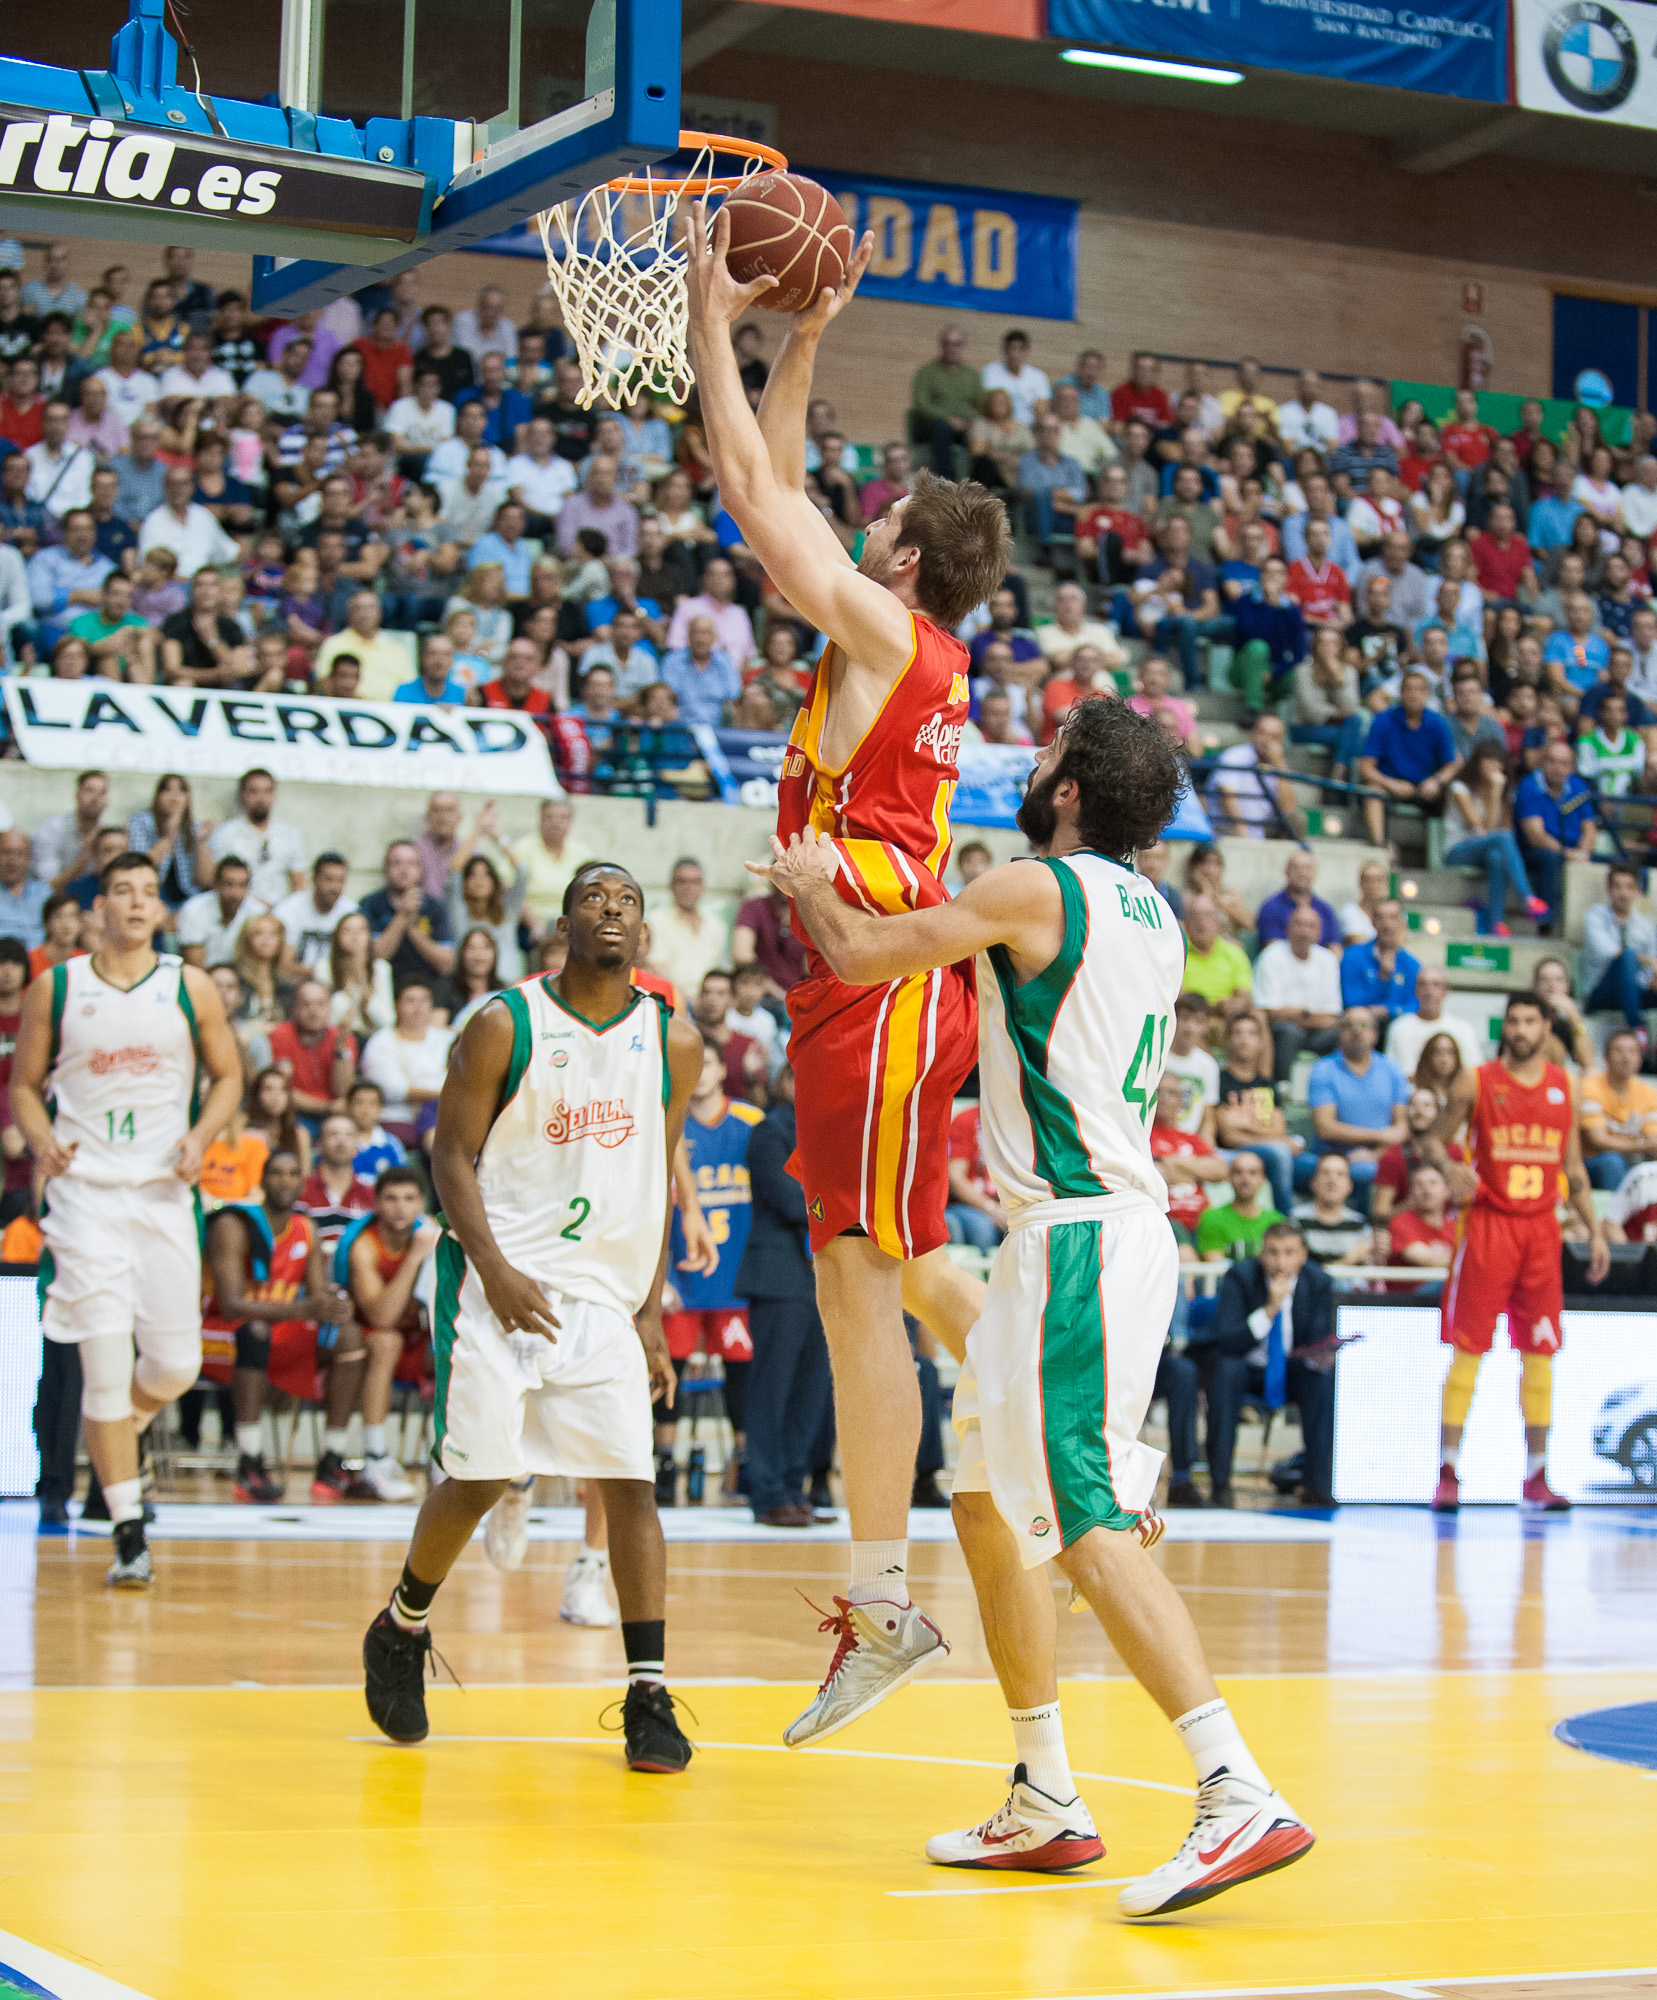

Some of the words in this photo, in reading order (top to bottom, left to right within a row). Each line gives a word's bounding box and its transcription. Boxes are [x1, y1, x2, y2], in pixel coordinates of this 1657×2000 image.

[0, 114, 283, 215] rtia.es
[105, 1109, 136, 1142] 14
[696, 1163, 751, 1189] CAM
[560, 1197, 590, 1242] 2
